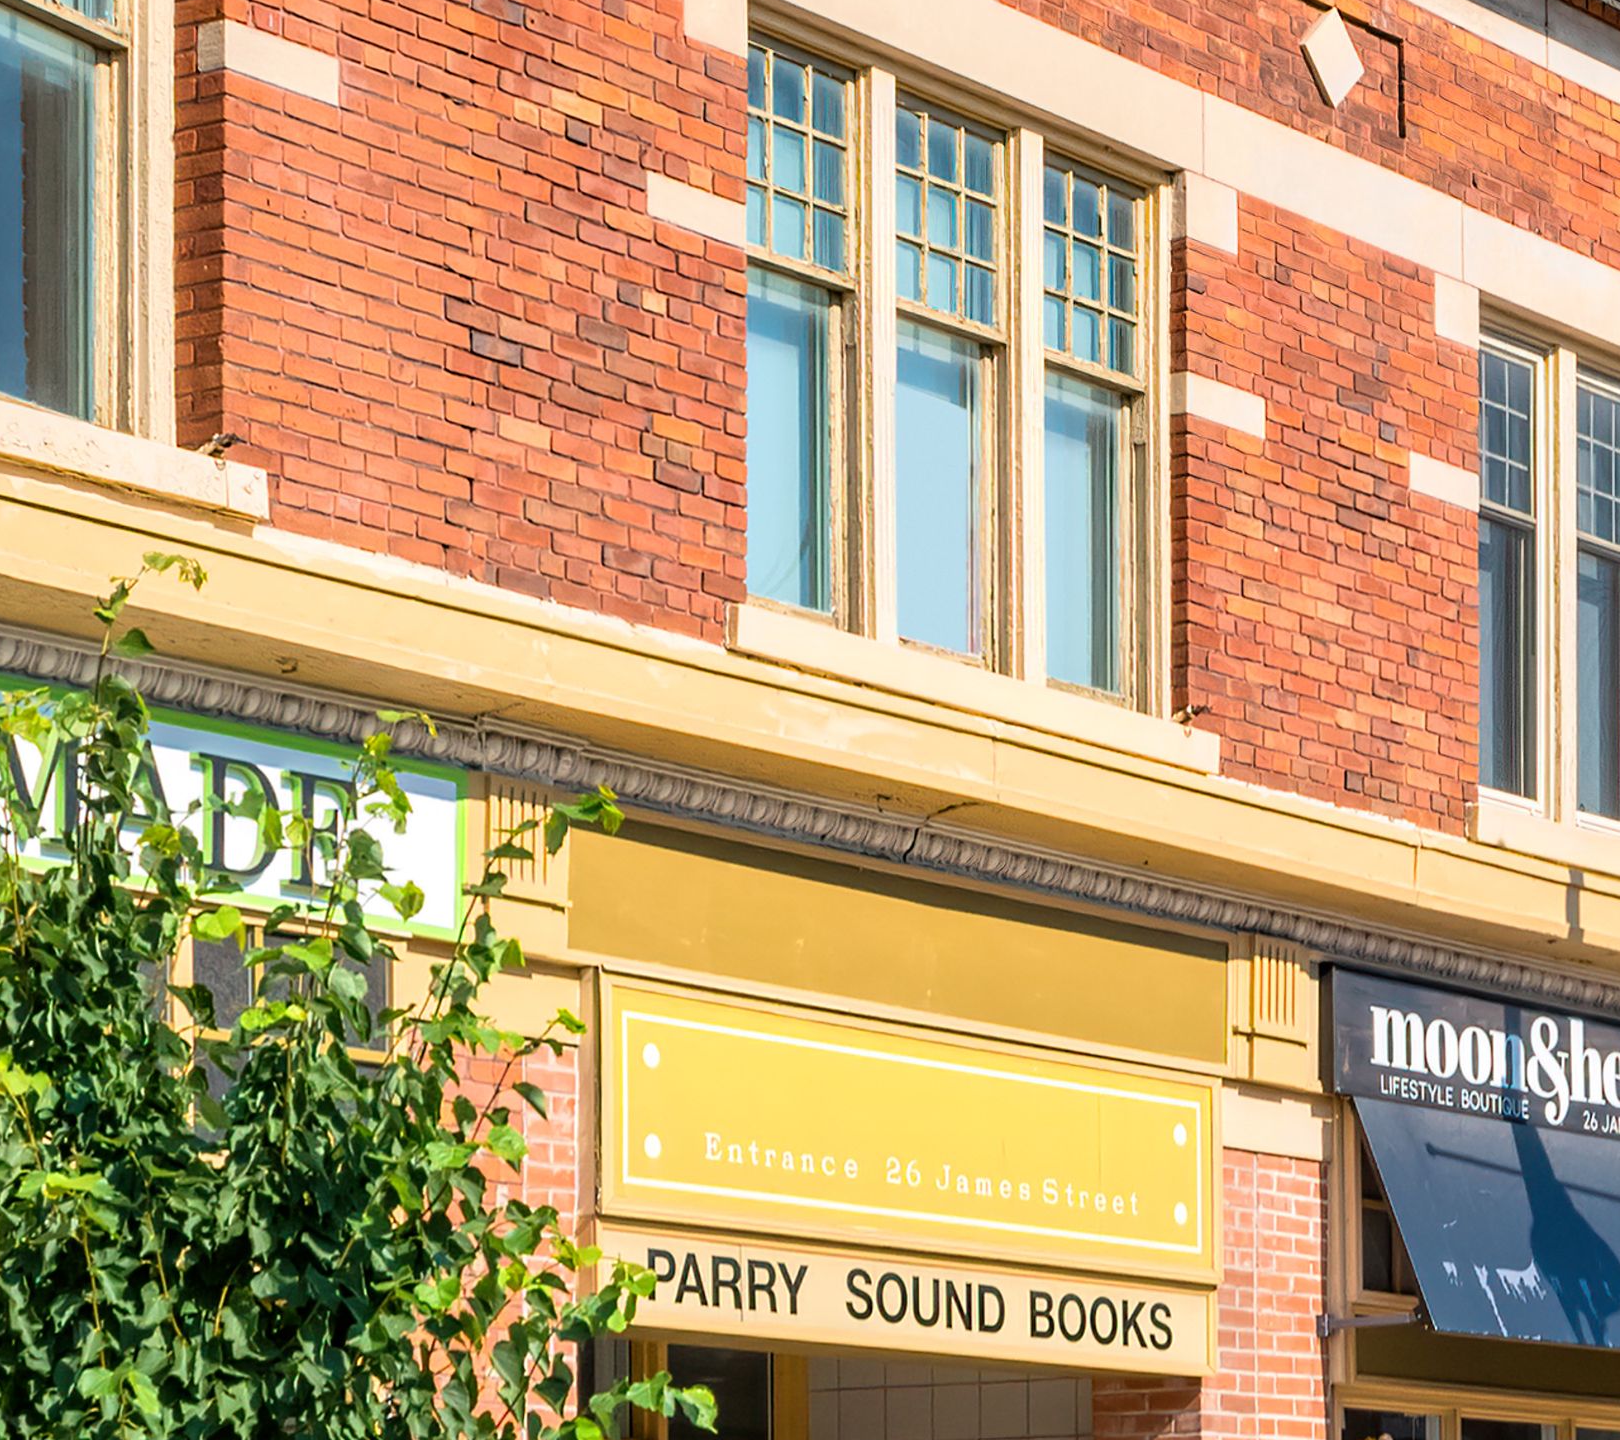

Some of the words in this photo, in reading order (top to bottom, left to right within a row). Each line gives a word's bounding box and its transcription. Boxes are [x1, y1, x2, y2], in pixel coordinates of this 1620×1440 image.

[1380, 1074, 1454, 1107] LIFESTYLE
[1461, 1089, 1530, 1121] BOUTIQUE
[1583, 1110, 1599, 1131] 26
[704, 1130, 859, 1180] Entrance
[886, 1156, 922, 1188] 26
[936, 1162, 1032, 1202] James
[1042, 1177, 1140, 1217] Street
[646, 1247, 809, 1317] PARRY
[845, 1268, 1006, 1334] SOUND
[1030, 1289, 1174, 1351] BOOKS
